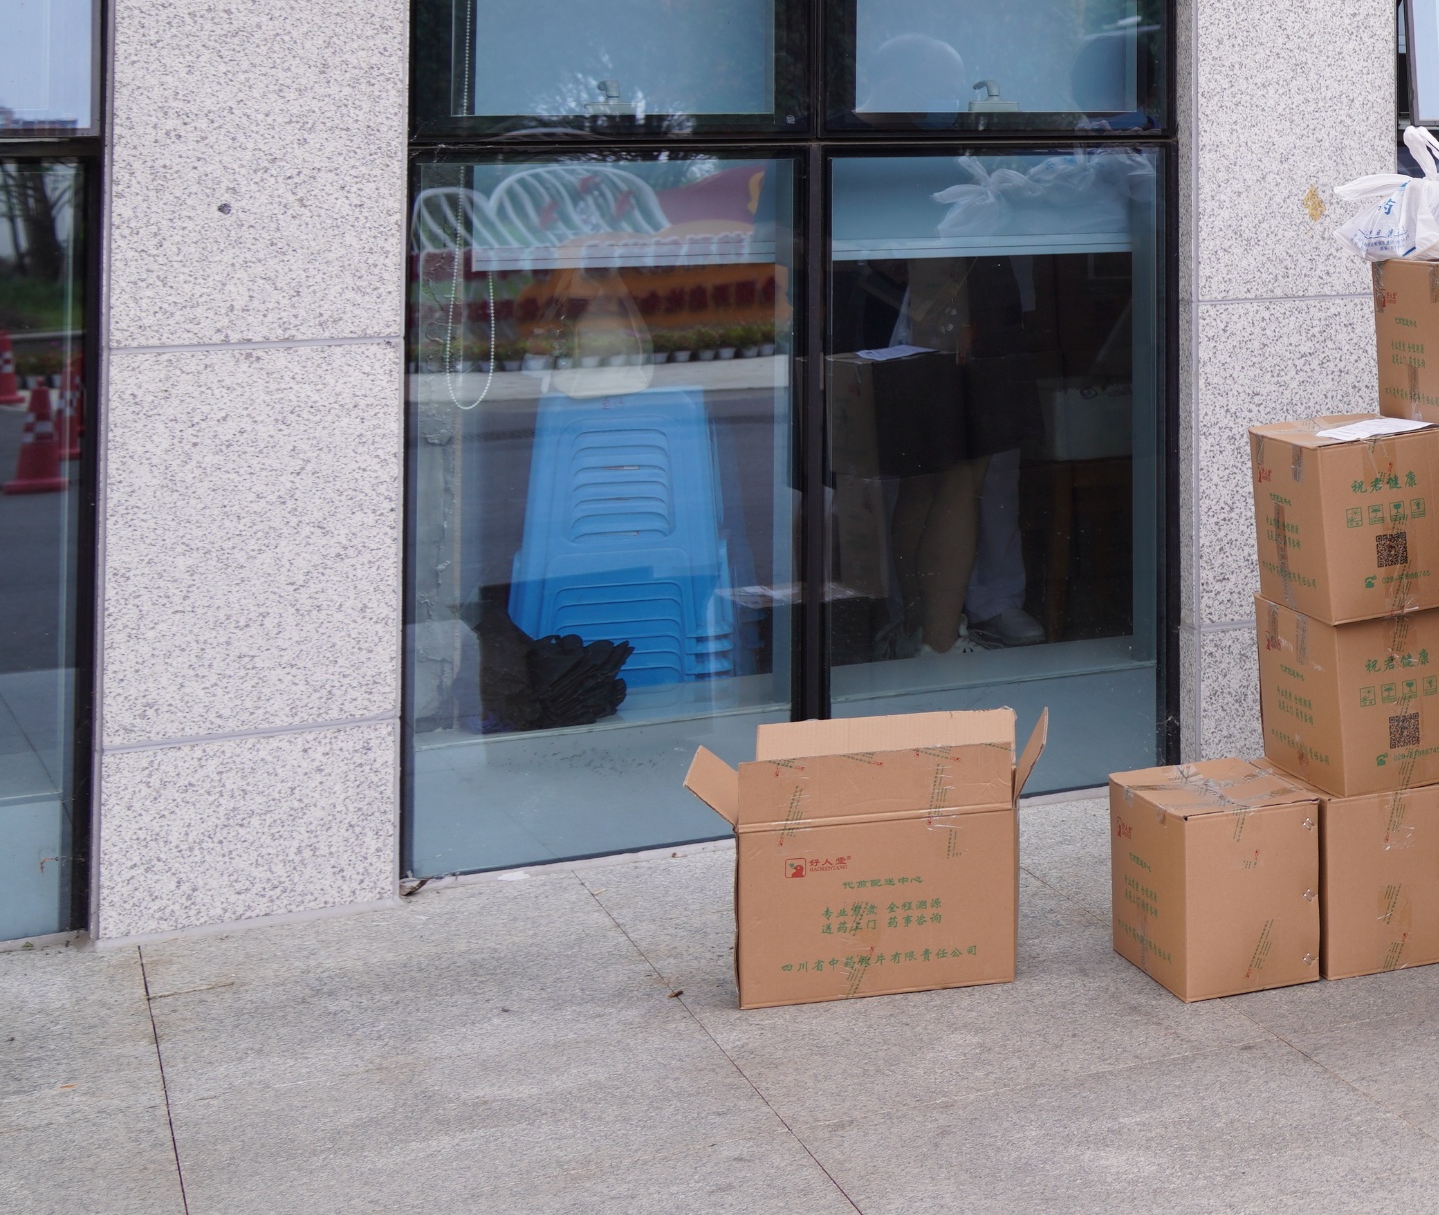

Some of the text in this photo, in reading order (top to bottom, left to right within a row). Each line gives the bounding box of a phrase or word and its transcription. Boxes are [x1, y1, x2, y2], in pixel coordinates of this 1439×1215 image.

[1350, 470, 1417, 494] 祝君健康
[1365, 648, 1430, 673] 祝君健康
